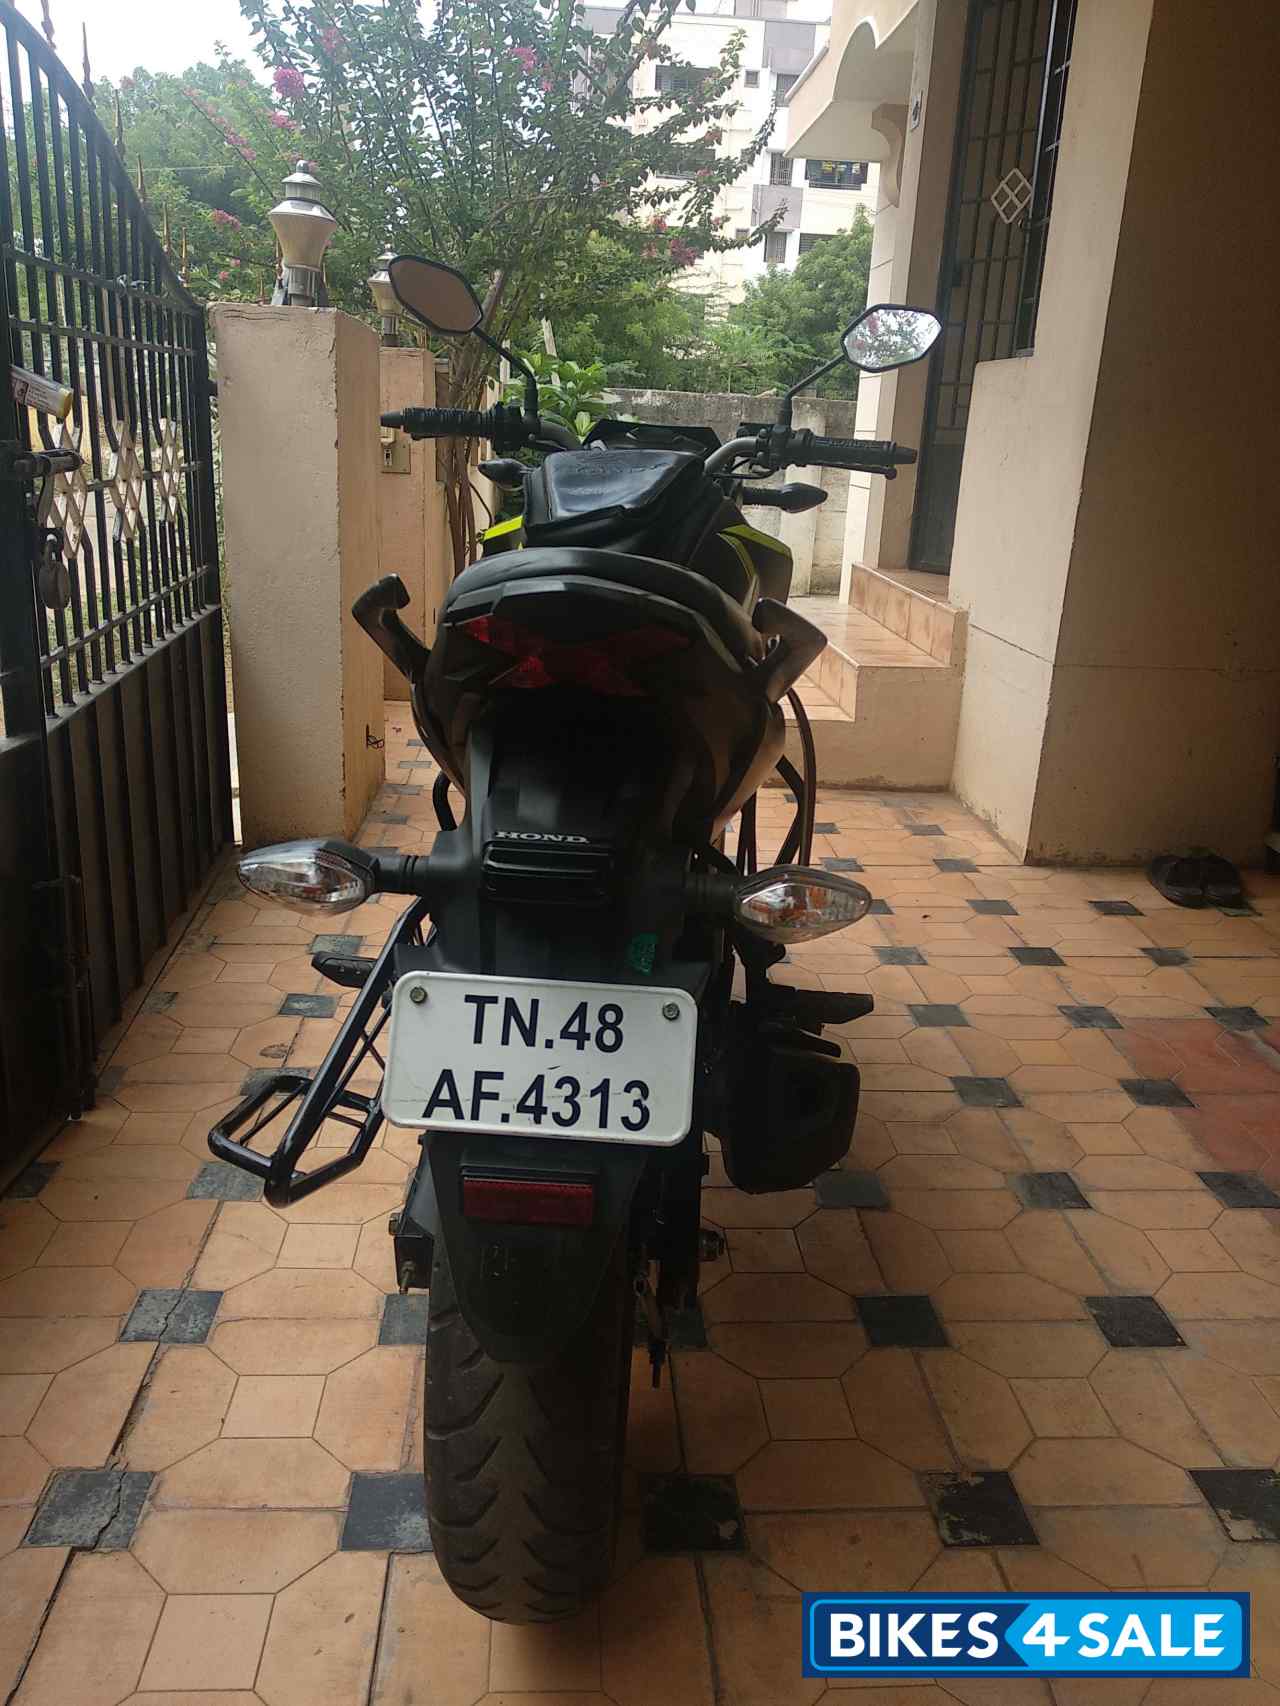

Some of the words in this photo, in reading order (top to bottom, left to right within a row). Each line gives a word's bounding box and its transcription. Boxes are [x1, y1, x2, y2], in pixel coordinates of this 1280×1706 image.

[495, 831, 592, 845] HOND
[464, 994, 624, 1053] TN.48
[422, 1069, 650, 1132] AF.4313
